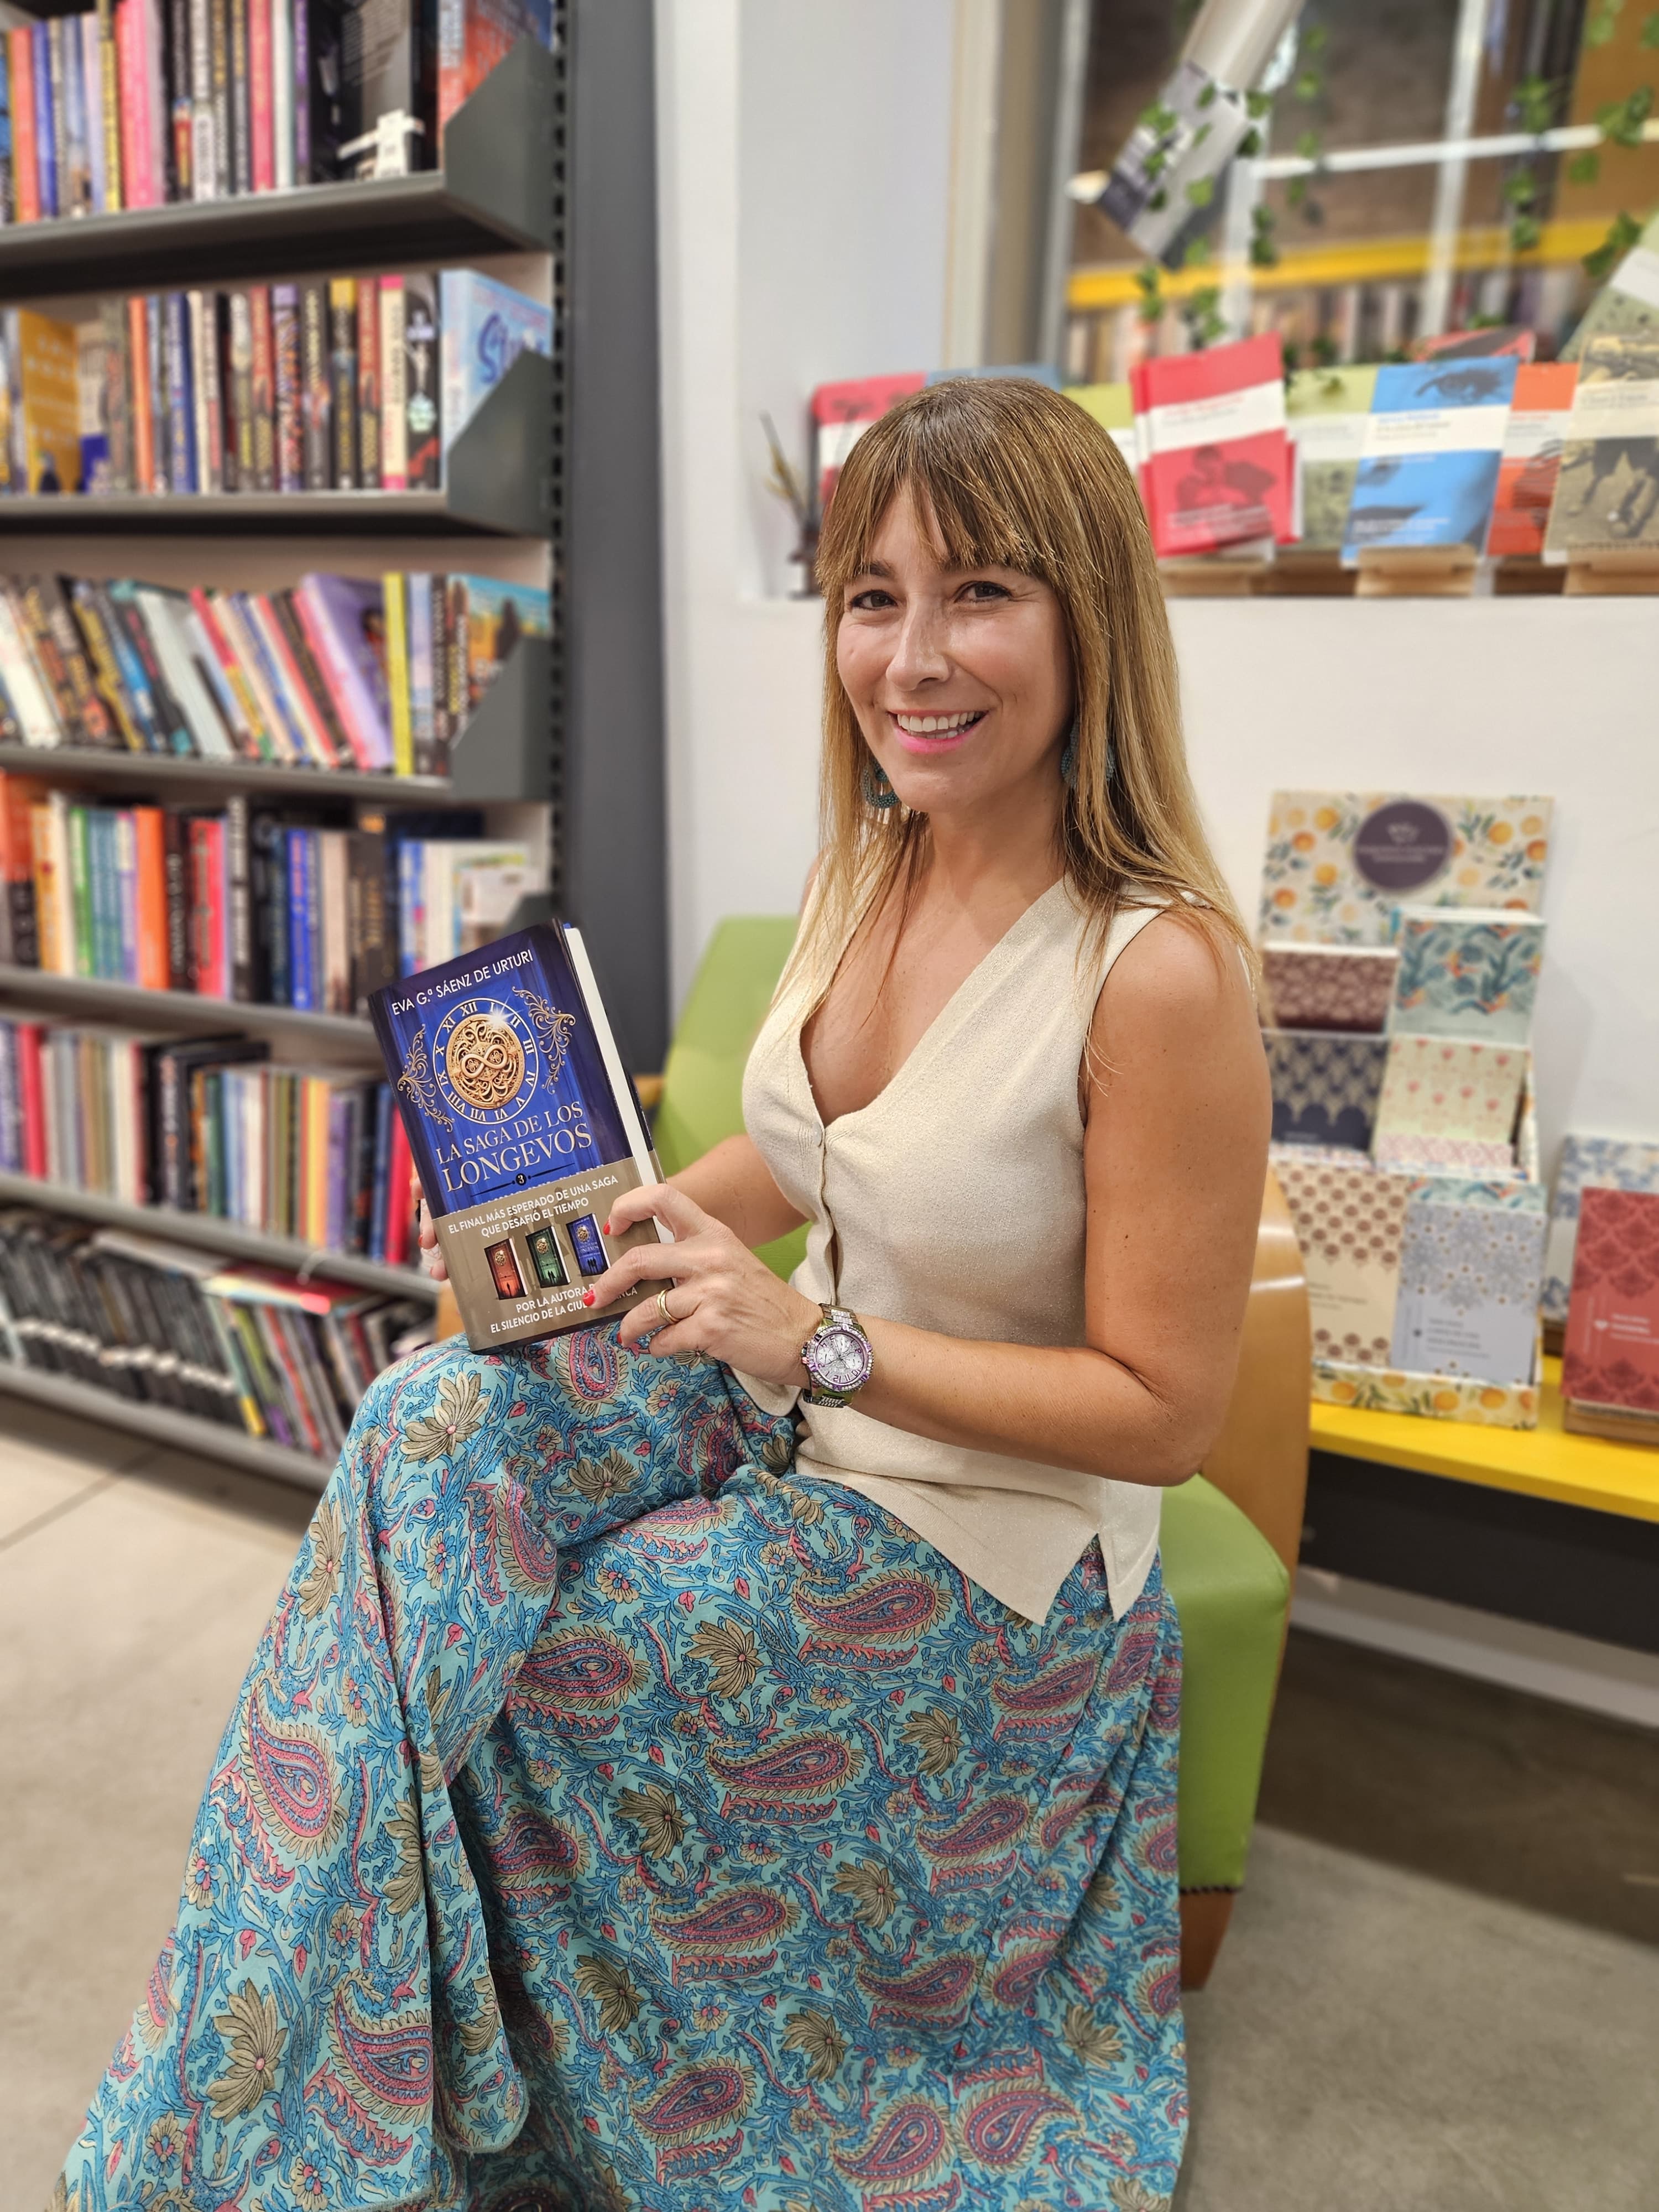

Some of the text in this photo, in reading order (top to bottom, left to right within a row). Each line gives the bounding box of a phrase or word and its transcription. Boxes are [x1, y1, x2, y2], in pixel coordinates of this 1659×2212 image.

[392, 998, 415, 1015] EVA
[436, 974, 472, 998] SÁENZ
[474, 966, 491, 983] DE
[493, 949, 533, 974] URTURI
[460, 1001, 478, 1017] XII
[443, 1016, 456, 1034] XI
[510, 1015, 521, 1029] II
[435, 1045, 445, 1056] X
[523, 1039, 534, 1055] III
[437, 1070, 449, 1086] IX
[525, 1070, 536, 1087] IV
[447, 1092, 466, 1114] VIII
[515, 1097, 526, 1108] V
[471, 1108, 486, 1121] VII
[494, 1108, 508, 1120] VI
[436, 1101, 583, 1165] LA SAGA DE LOS
[442, 1123, 592, 1192] LONGEVOS
[517, 1174, 525, 1184] 3
[448, 1224, 460, 1234] EL
[460, 1217, 486, 1230] FINAL
[487, 1208, 506, 1223] MÁS
[507, 1194, 554, 1216] ESPERADO
[557, 1190, 571, 1201] DE
[571, 1182, 592, 1197] UNA
[592, 1175, 618, 1190] SAGA
[481, 1197, 589, 1237] QUE DESAFIÓ EL TIEMPO
[516, 1301, 536, 1313] POR
[537, 1296, 550, 1307] LA
[551, 1286, 588, 1304] AUTORA
[491, 1324, 500, 1333] EL
[501, 1313, 540, 1331] SILENCIO
[541, 1309, 554, 1319] DE
[555, 1305, 566, 1316] LA
[567, 1300, 588, 1312] CIU
